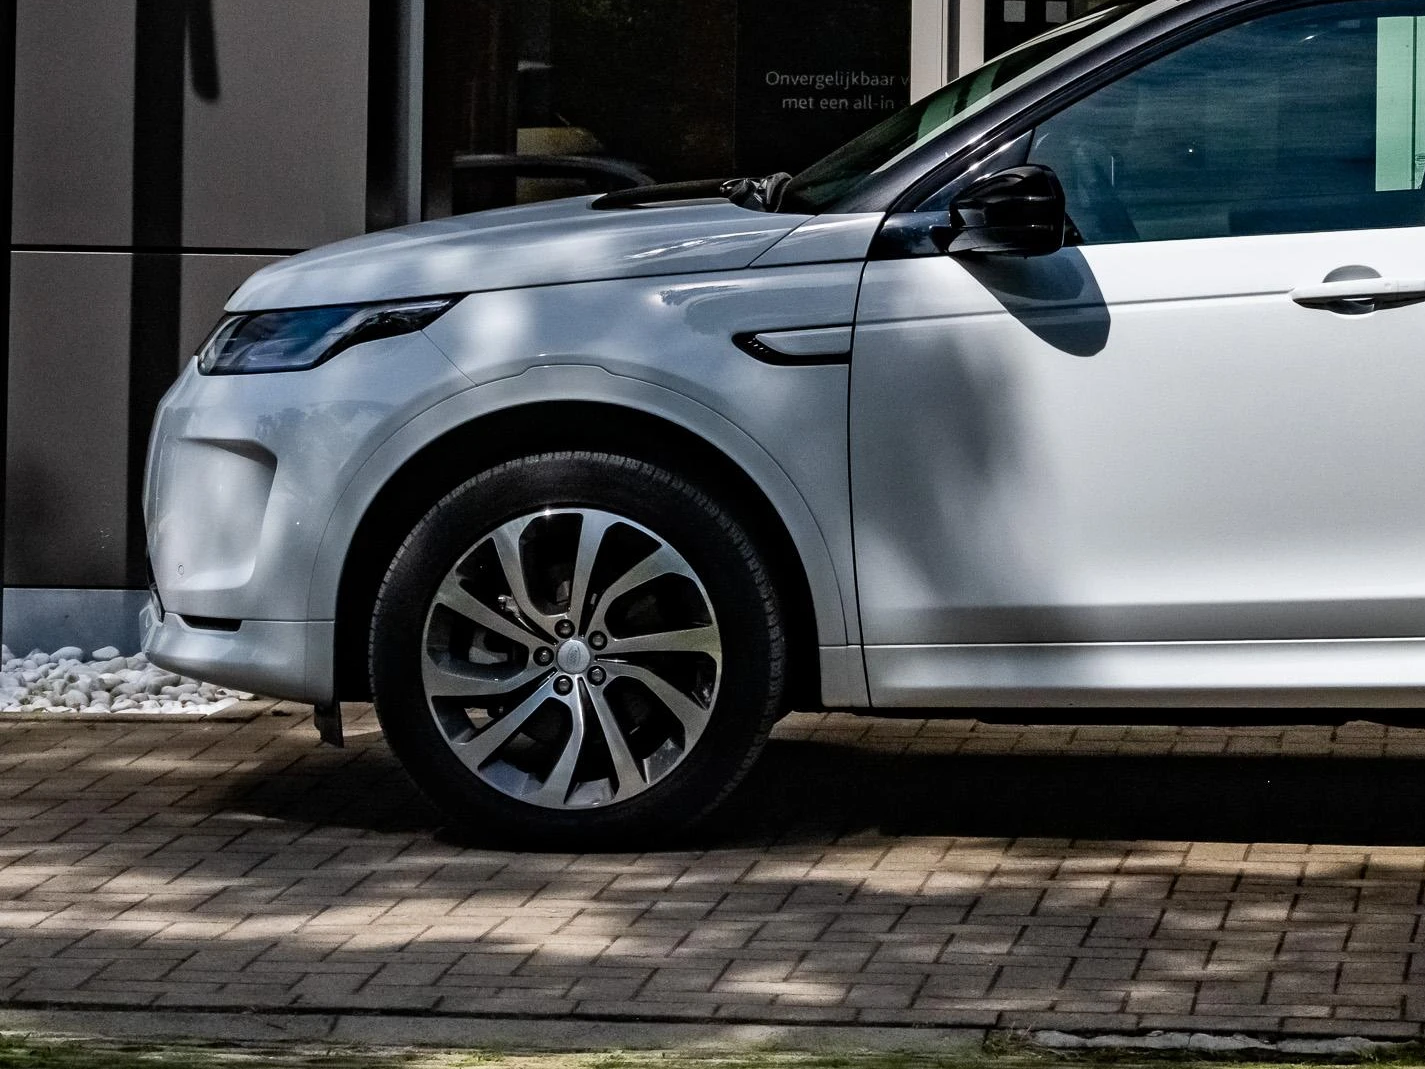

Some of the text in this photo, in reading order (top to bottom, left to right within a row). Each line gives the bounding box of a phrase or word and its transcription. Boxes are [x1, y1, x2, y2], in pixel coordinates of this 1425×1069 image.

[765, 70, 896, 90] Onvergelijkbaar
[782, 96, 815, 110] met
[820, 98, 849, 110] een
[853, 94, 895, 110] all-in
